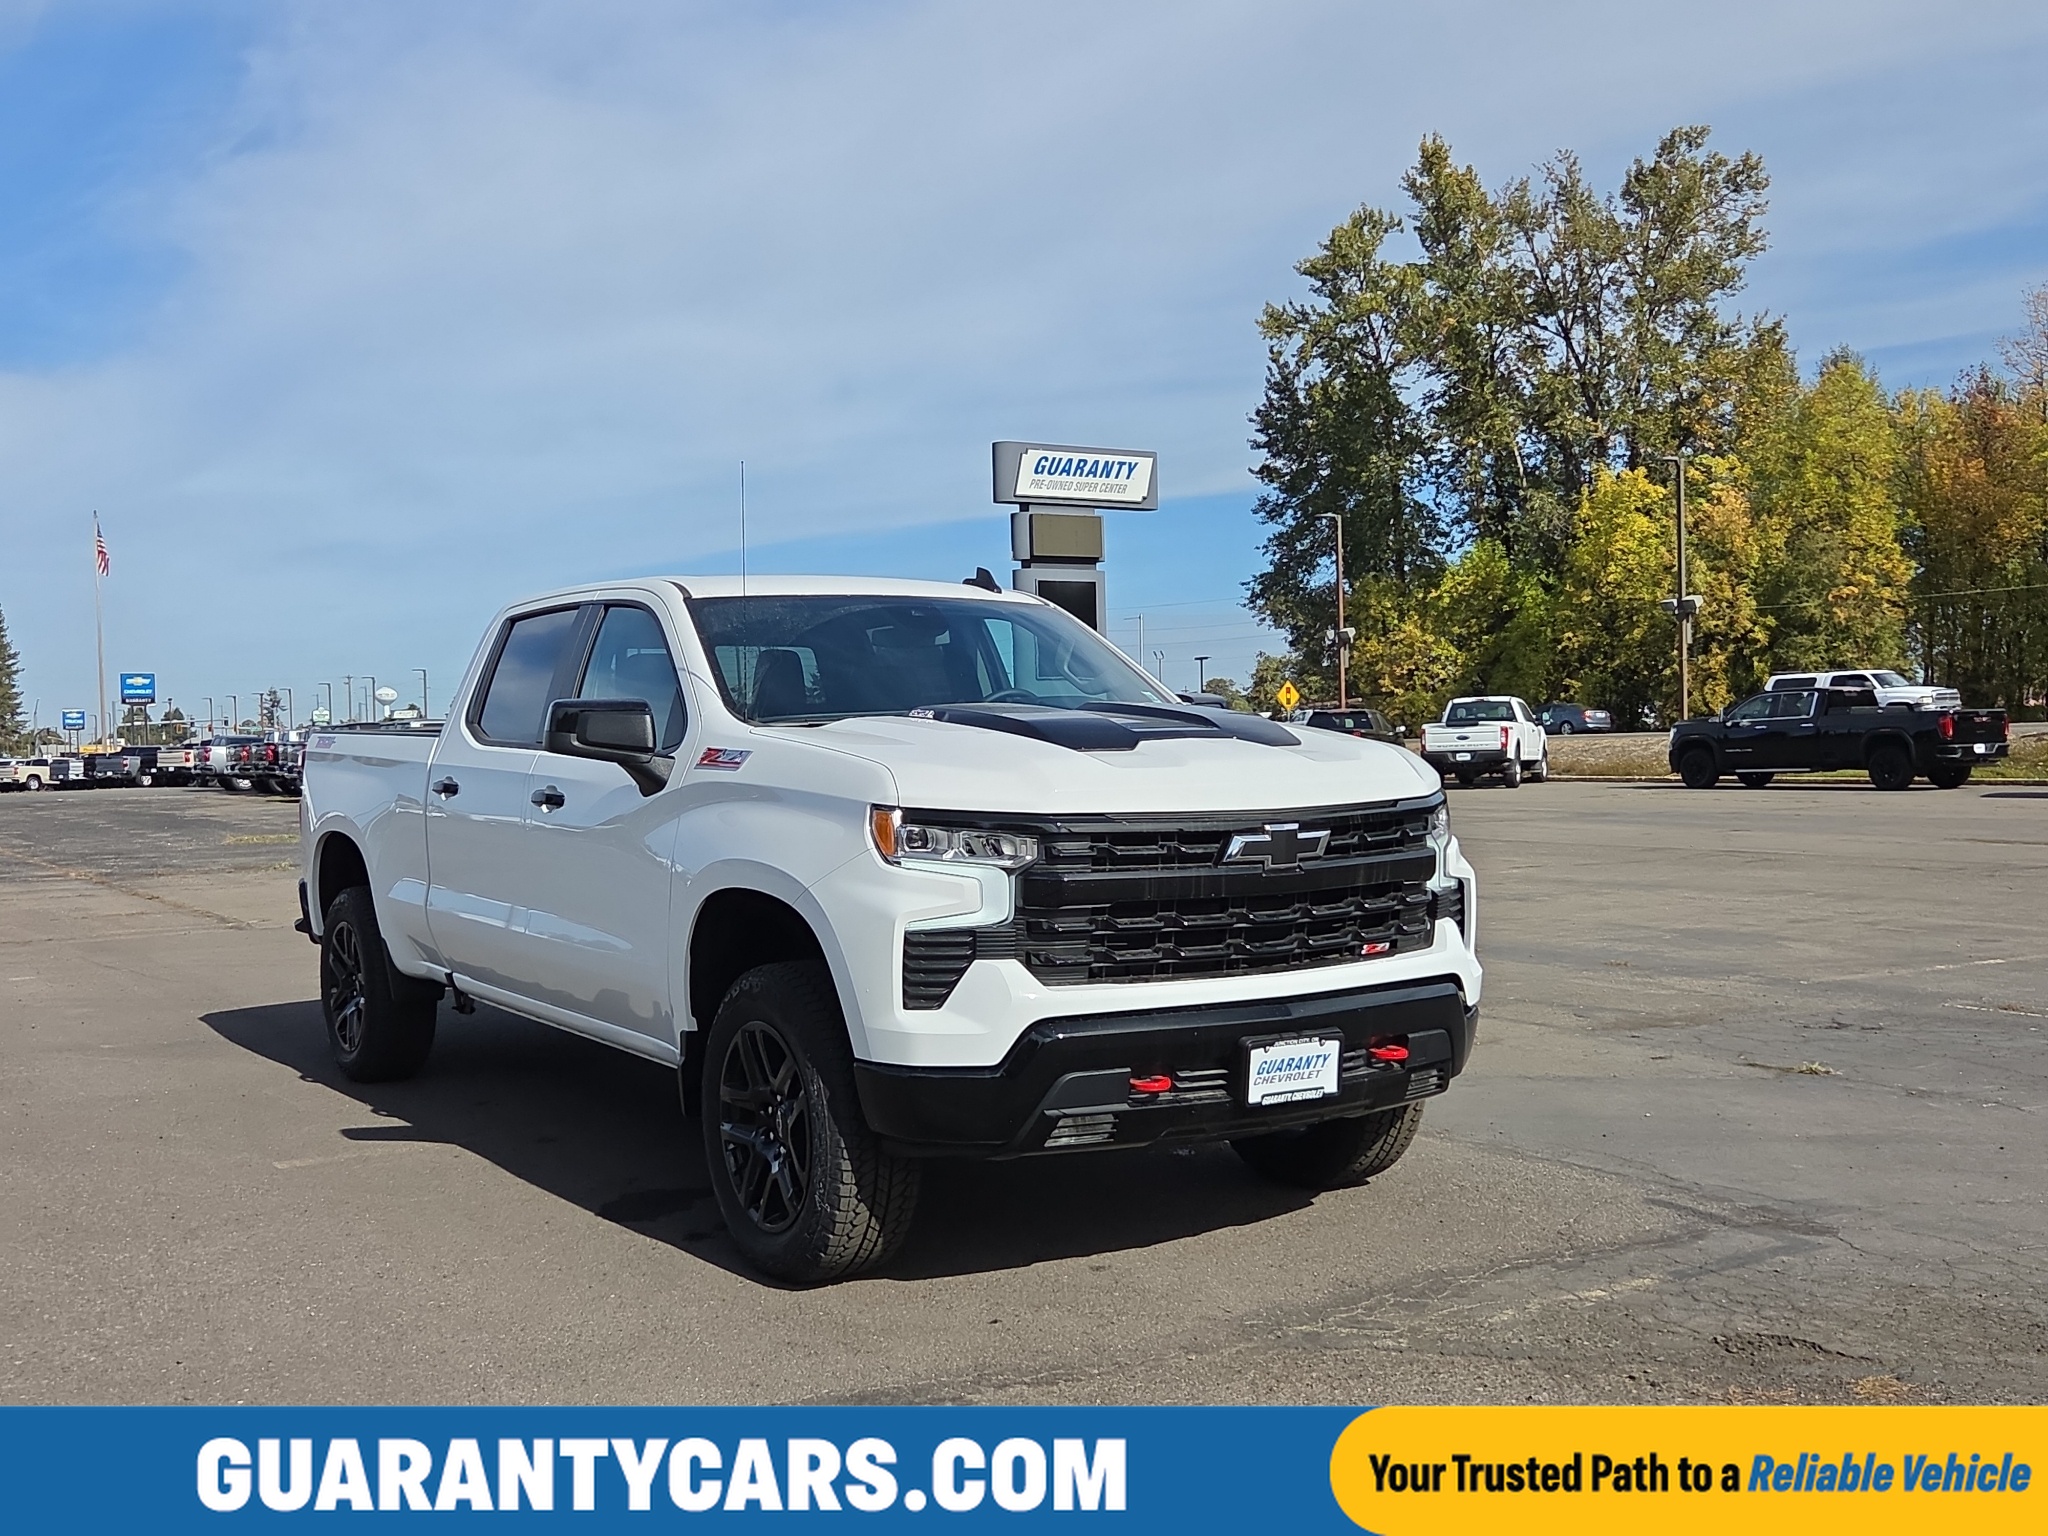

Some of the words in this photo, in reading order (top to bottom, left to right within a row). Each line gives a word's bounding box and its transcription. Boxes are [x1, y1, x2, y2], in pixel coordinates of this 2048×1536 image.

[1033, 456, 1139, 480] GUARANTY
[1029, 478, 1073, 491] PRE-OWNED
[1074, 481, 1098, 493] SUPER
[1099, 482, 1128, 494] CENTER
[1256, 1053, 1331, 1075] GUARANTY
[1253, 1069, 1322, 1086] CHEVROLET
